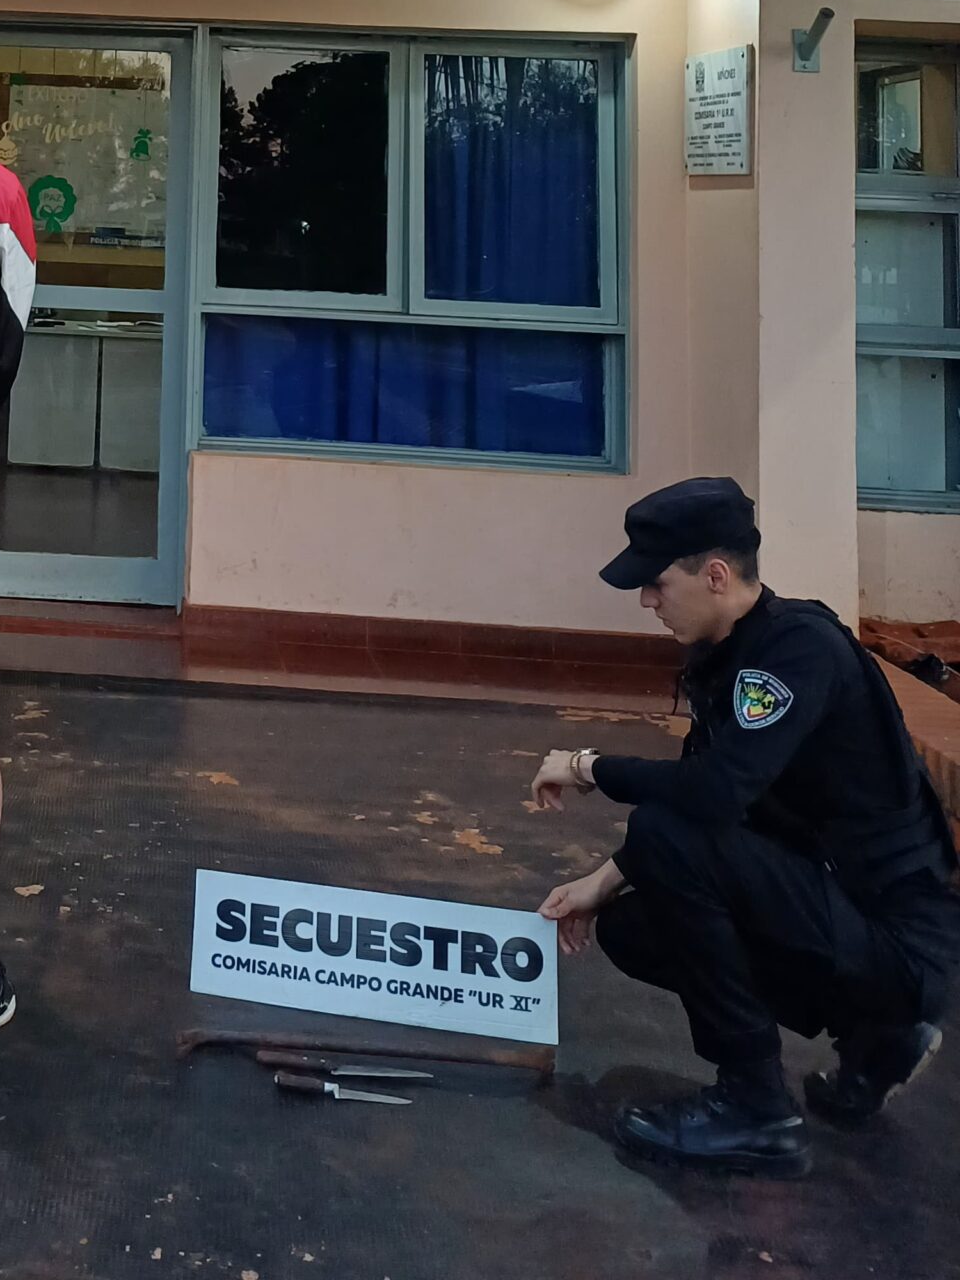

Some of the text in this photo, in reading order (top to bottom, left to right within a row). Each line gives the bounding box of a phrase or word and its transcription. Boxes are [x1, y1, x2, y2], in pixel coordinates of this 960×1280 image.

[43, 192, 62, 202] PAZ
[215, 898, 544, 983] SECUESTRO
[210, 952, 311, 982] COMISARIA
[315, 969, 382, 992] CAMPO
[386, 979, 465, 1004] GRANDE
